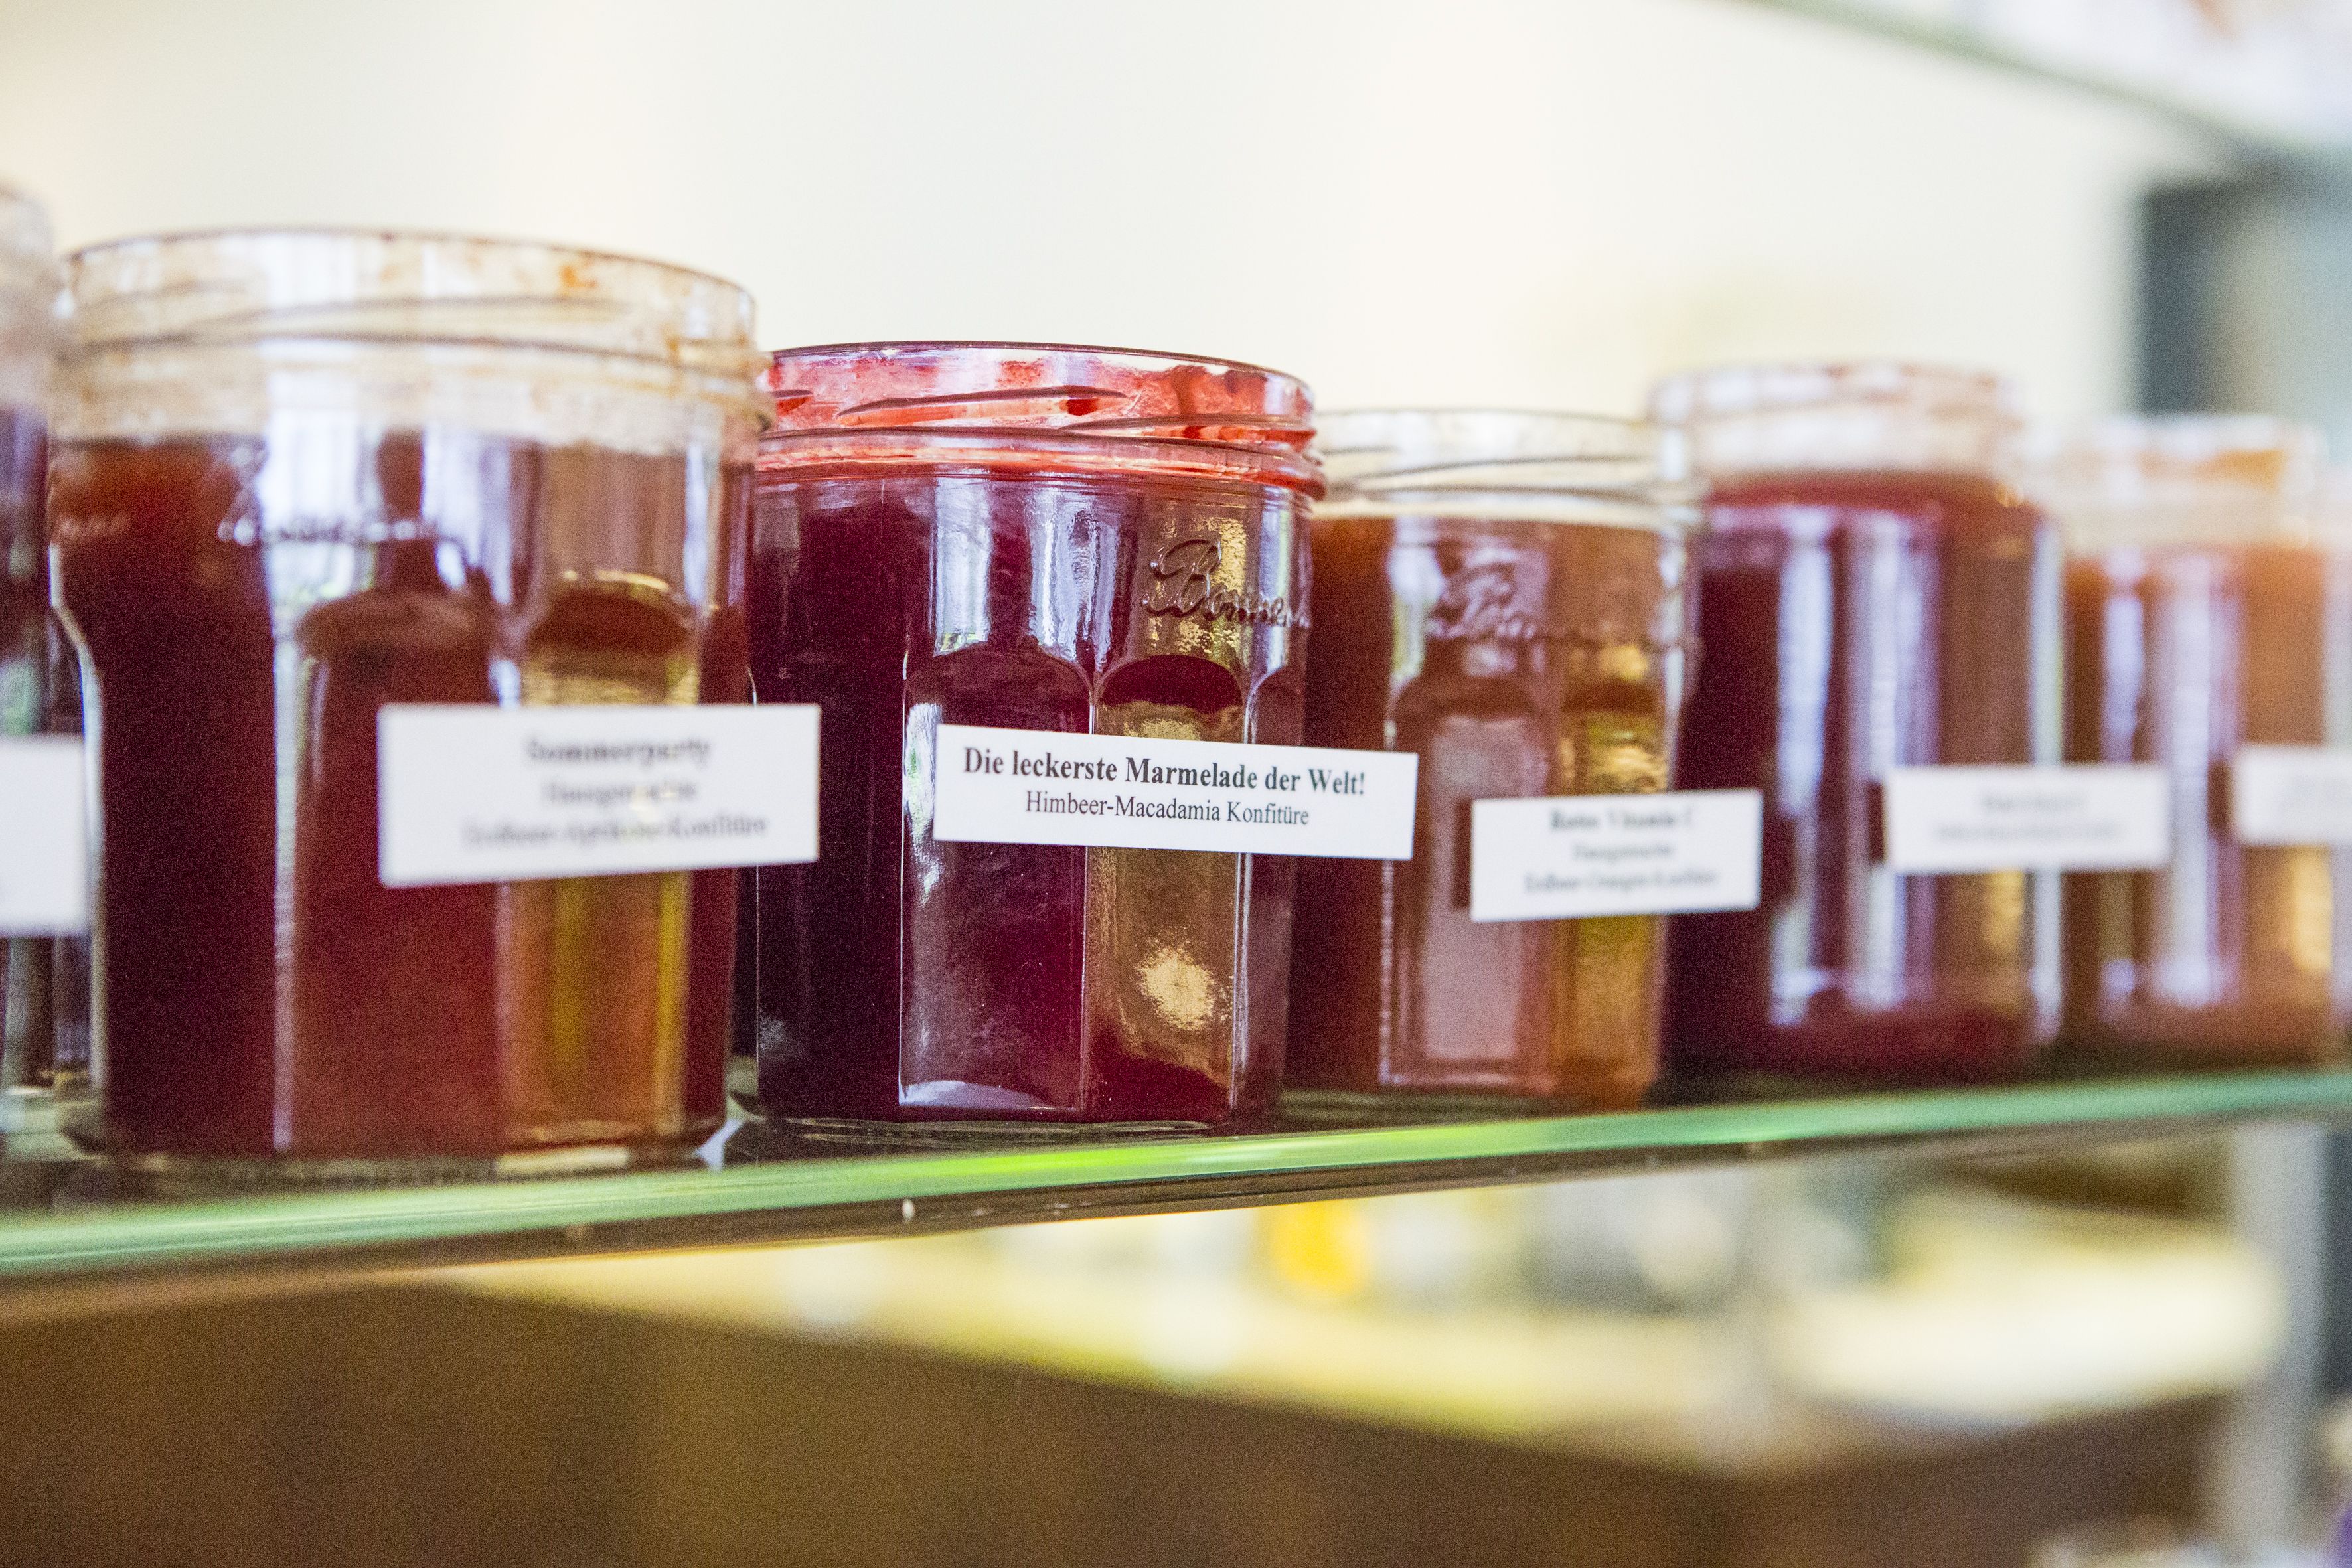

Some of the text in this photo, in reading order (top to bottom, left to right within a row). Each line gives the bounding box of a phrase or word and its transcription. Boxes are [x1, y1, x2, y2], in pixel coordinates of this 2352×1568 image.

[964, 747, 1365, 795] Die leckerste Marmelade der Welt!
[1026, 790, 1309, 825] Himbeer-Macadamia Konfitüre
